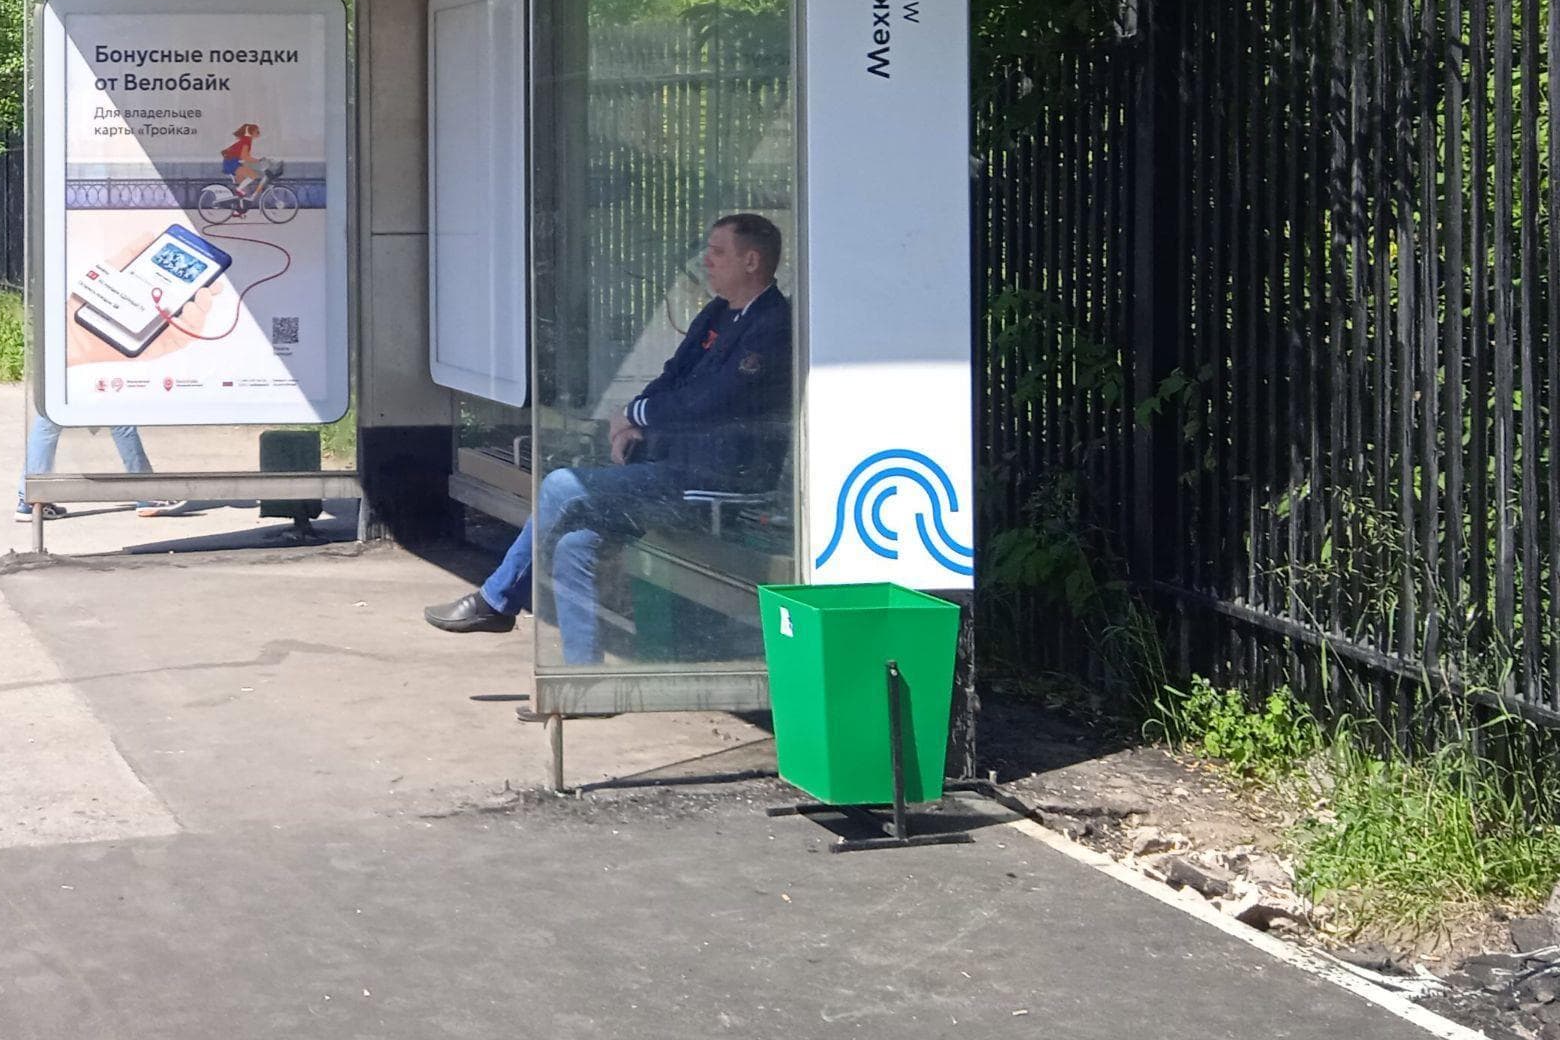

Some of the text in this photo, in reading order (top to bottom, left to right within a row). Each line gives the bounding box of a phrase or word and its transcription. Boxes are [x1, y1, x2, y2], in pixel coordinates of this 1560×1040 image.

[94, 45, 299, 67] Бонусные поездки
[94, 72, 231, 92] от Велобайк
[93, 106, 203, 121] Для владельцев
[93, 122, 198, 137] карты «Тройка»
